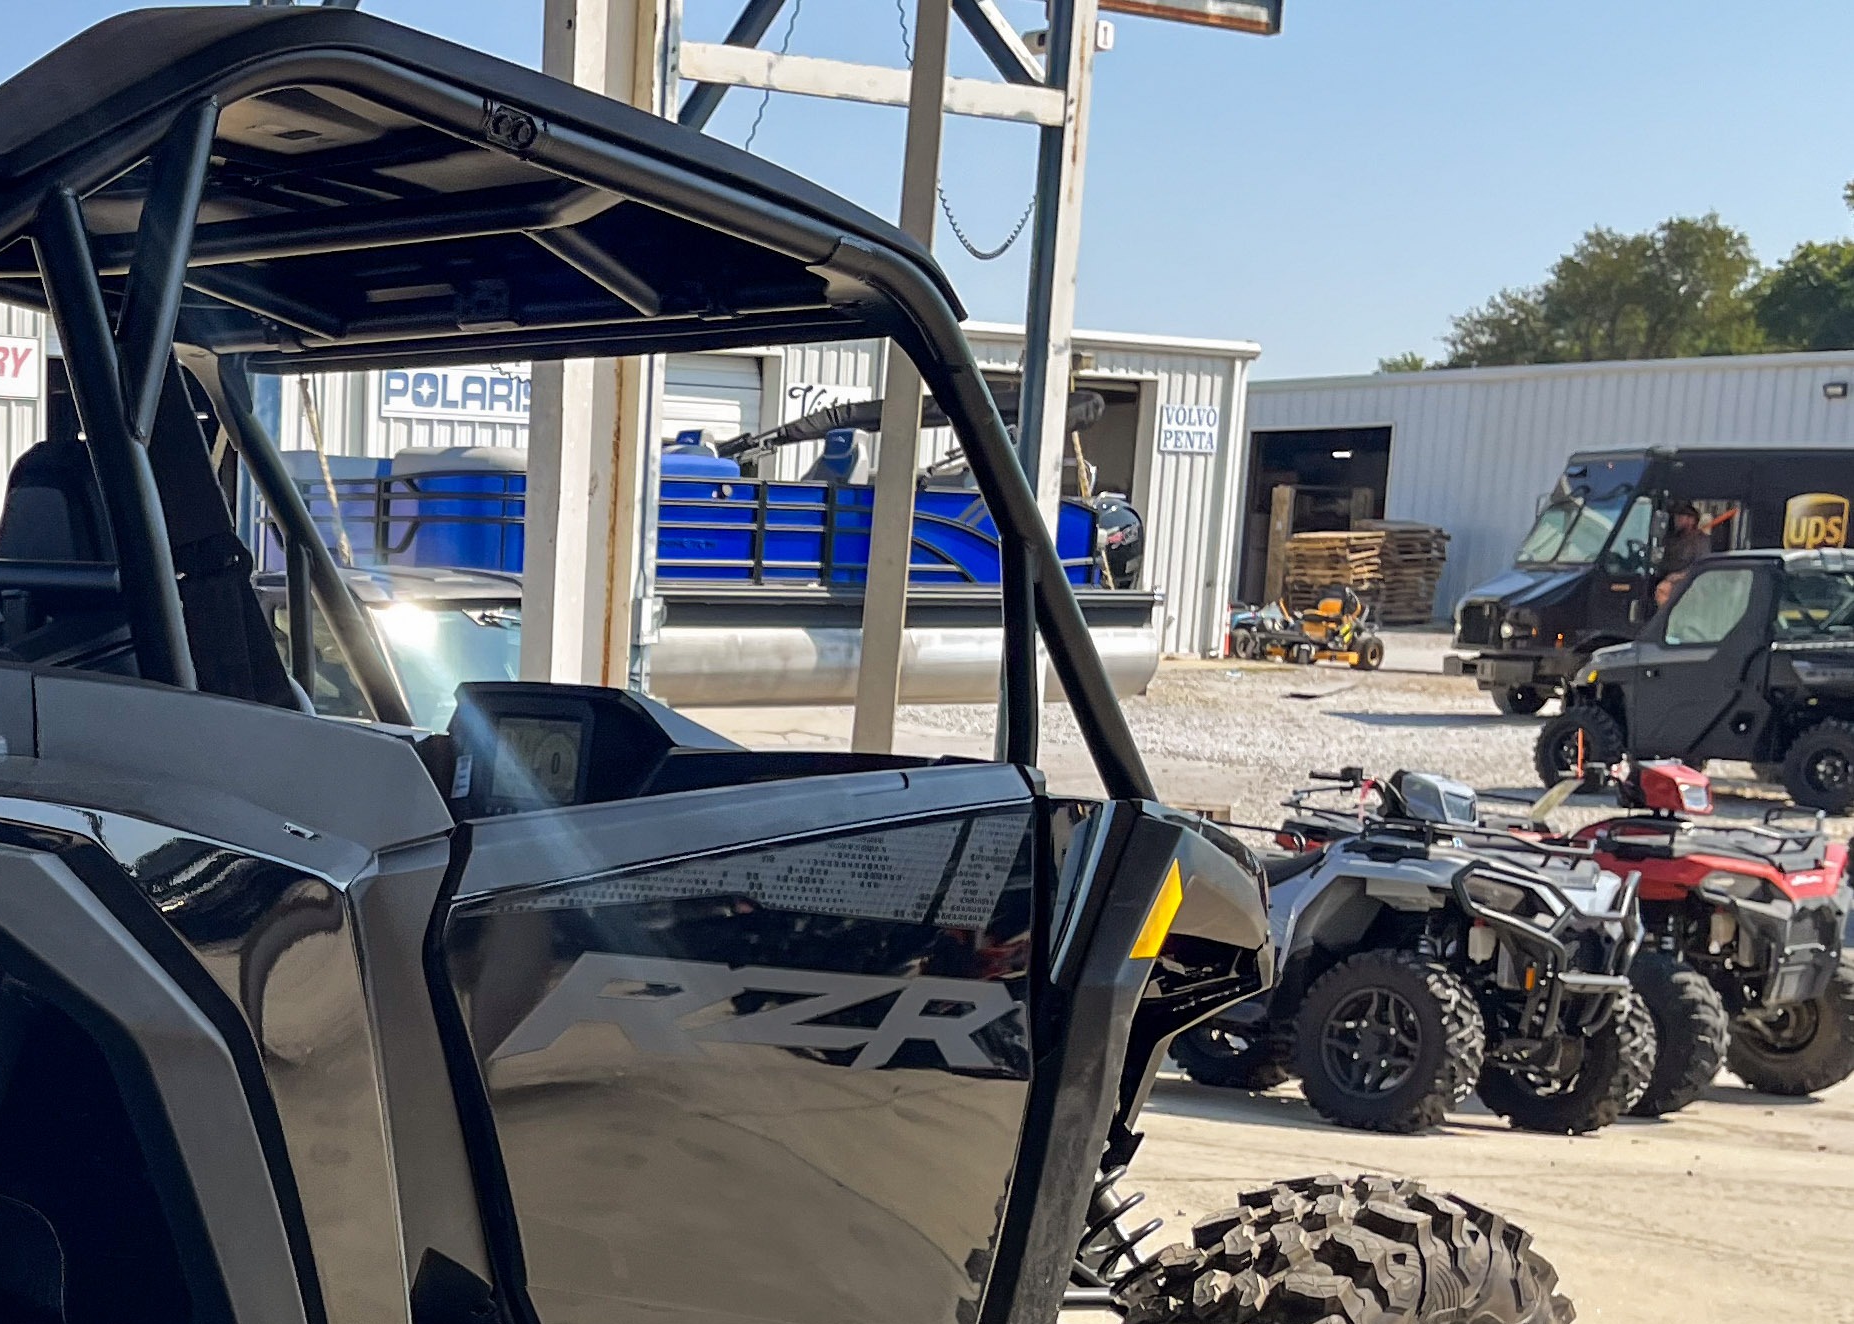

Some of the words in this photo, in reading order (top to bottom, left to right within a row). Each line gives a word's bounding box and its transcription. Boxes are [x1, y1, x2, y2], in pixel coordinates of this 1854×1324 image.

[1165, 406, 1217, 428] VOLVO
[1163, 429, 1215, 450] PENTA
[487, 950, 1022, 1070] RZR
